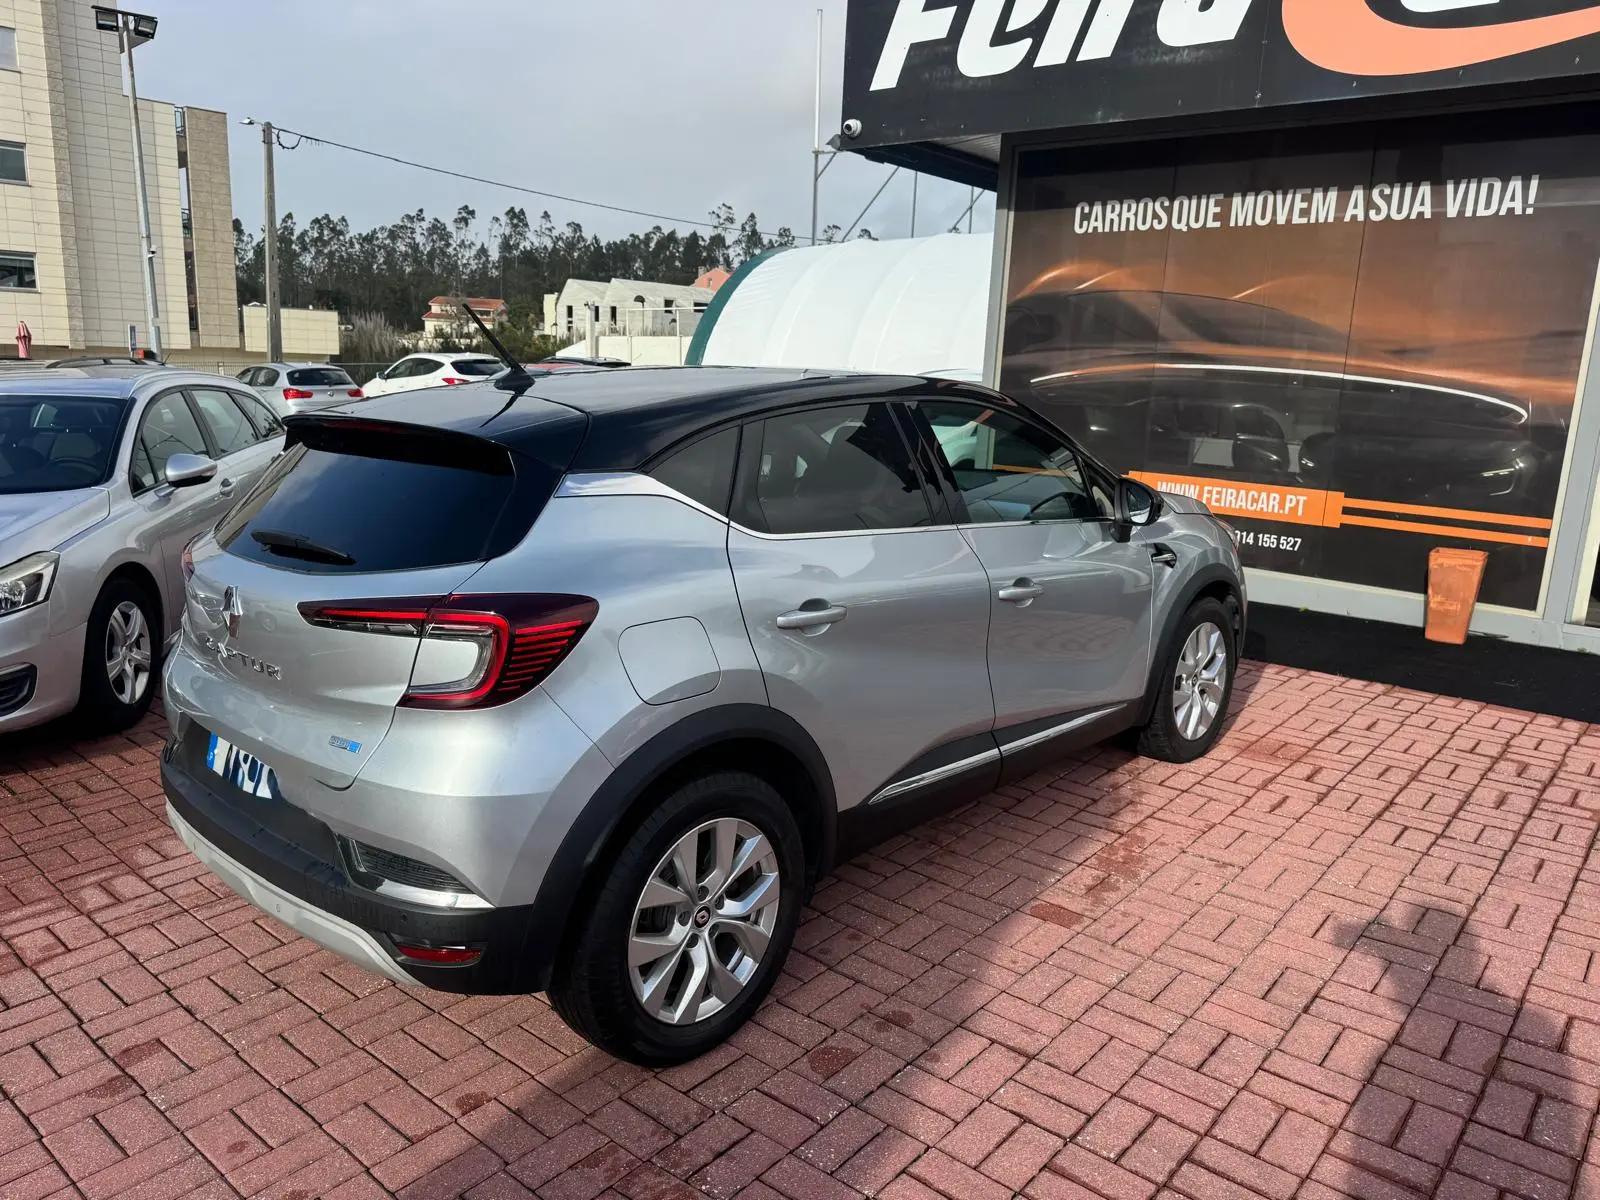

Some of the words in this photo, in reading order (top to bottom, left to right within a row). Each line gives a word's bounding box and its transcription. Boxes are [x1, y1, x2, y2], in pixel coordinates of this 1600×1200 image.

[1074, 197, 1169, 234] CARROS
[1171, 194, 1224, 232] QUE
[1229, 187, 1338, 227] MOVEM
[1344, 185, 1365, 222] A
[1369, 181, 1432, 222] SUA
[1446, 174, 1540, 218] VIDA!
[1257, 533, 1277, 548] 155
[1279, 535, 1302, 552] 527
